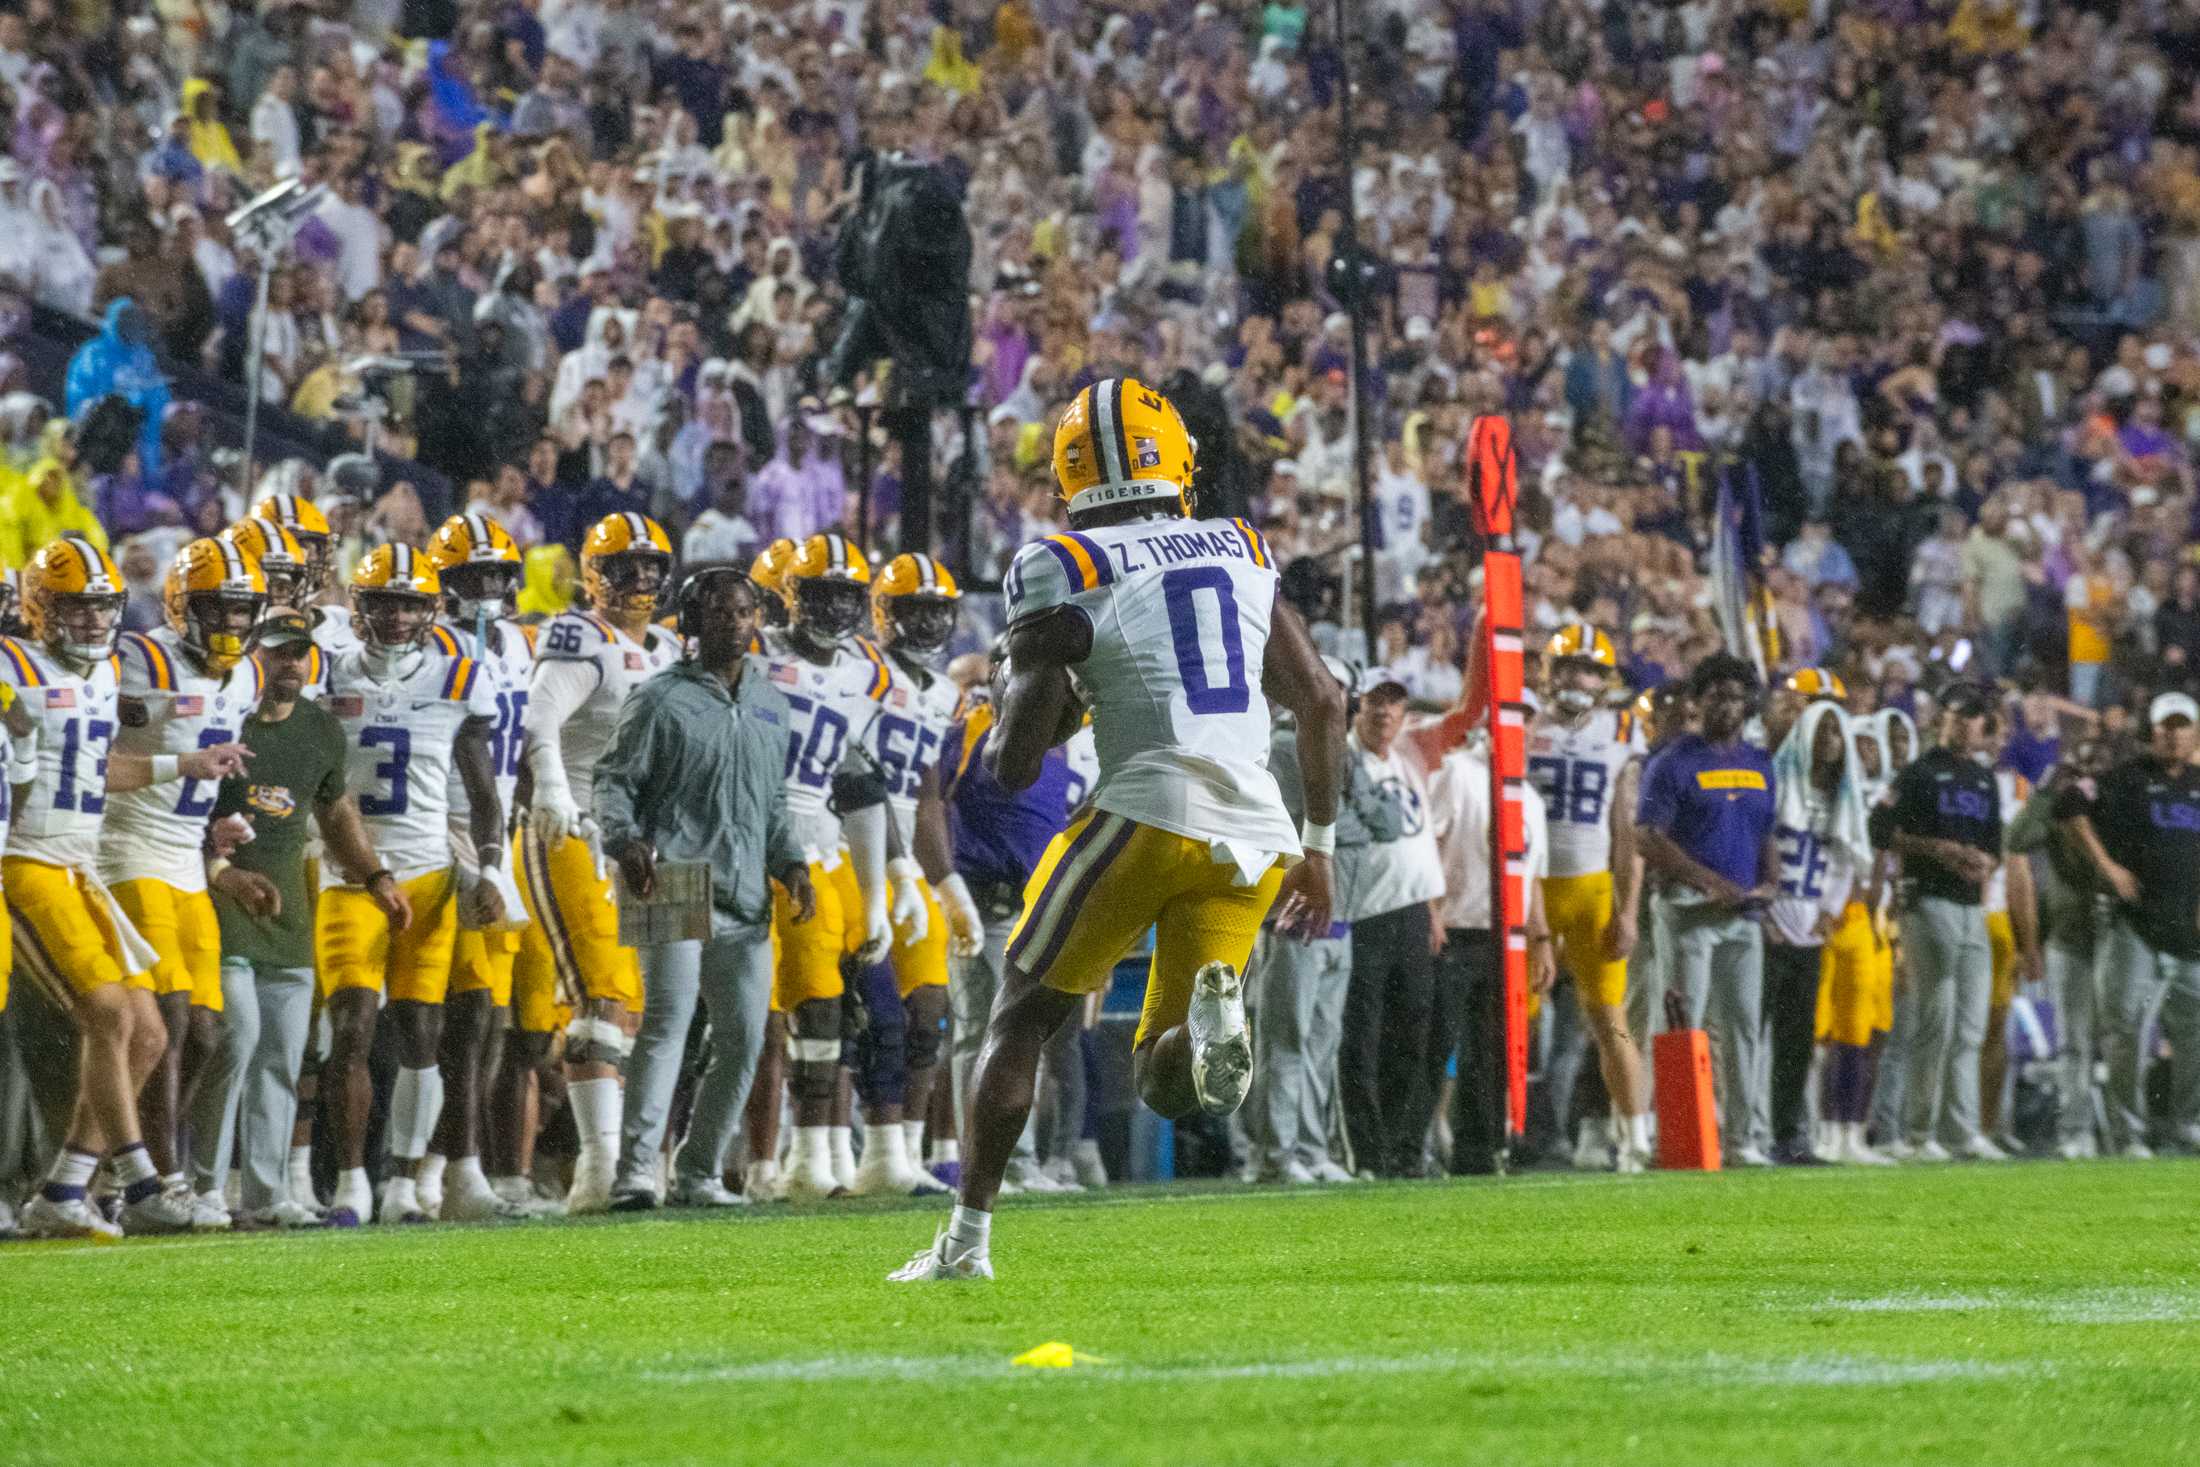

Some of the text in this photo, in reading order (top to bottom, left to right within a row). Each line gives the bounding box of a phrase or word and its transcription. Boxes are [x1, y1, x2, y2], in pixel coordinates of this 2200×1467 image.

[1087, 484, 1156, 503] TIGERS
[547, 623, 583, 653] 66
[1162, 566, 1249, 715] 0
[54, 718, 113, 815] 13
[174, 728, 234, 817] 2
[359, 726, 411, 815] 3
[1937, 787, 1990, 821] LSU
